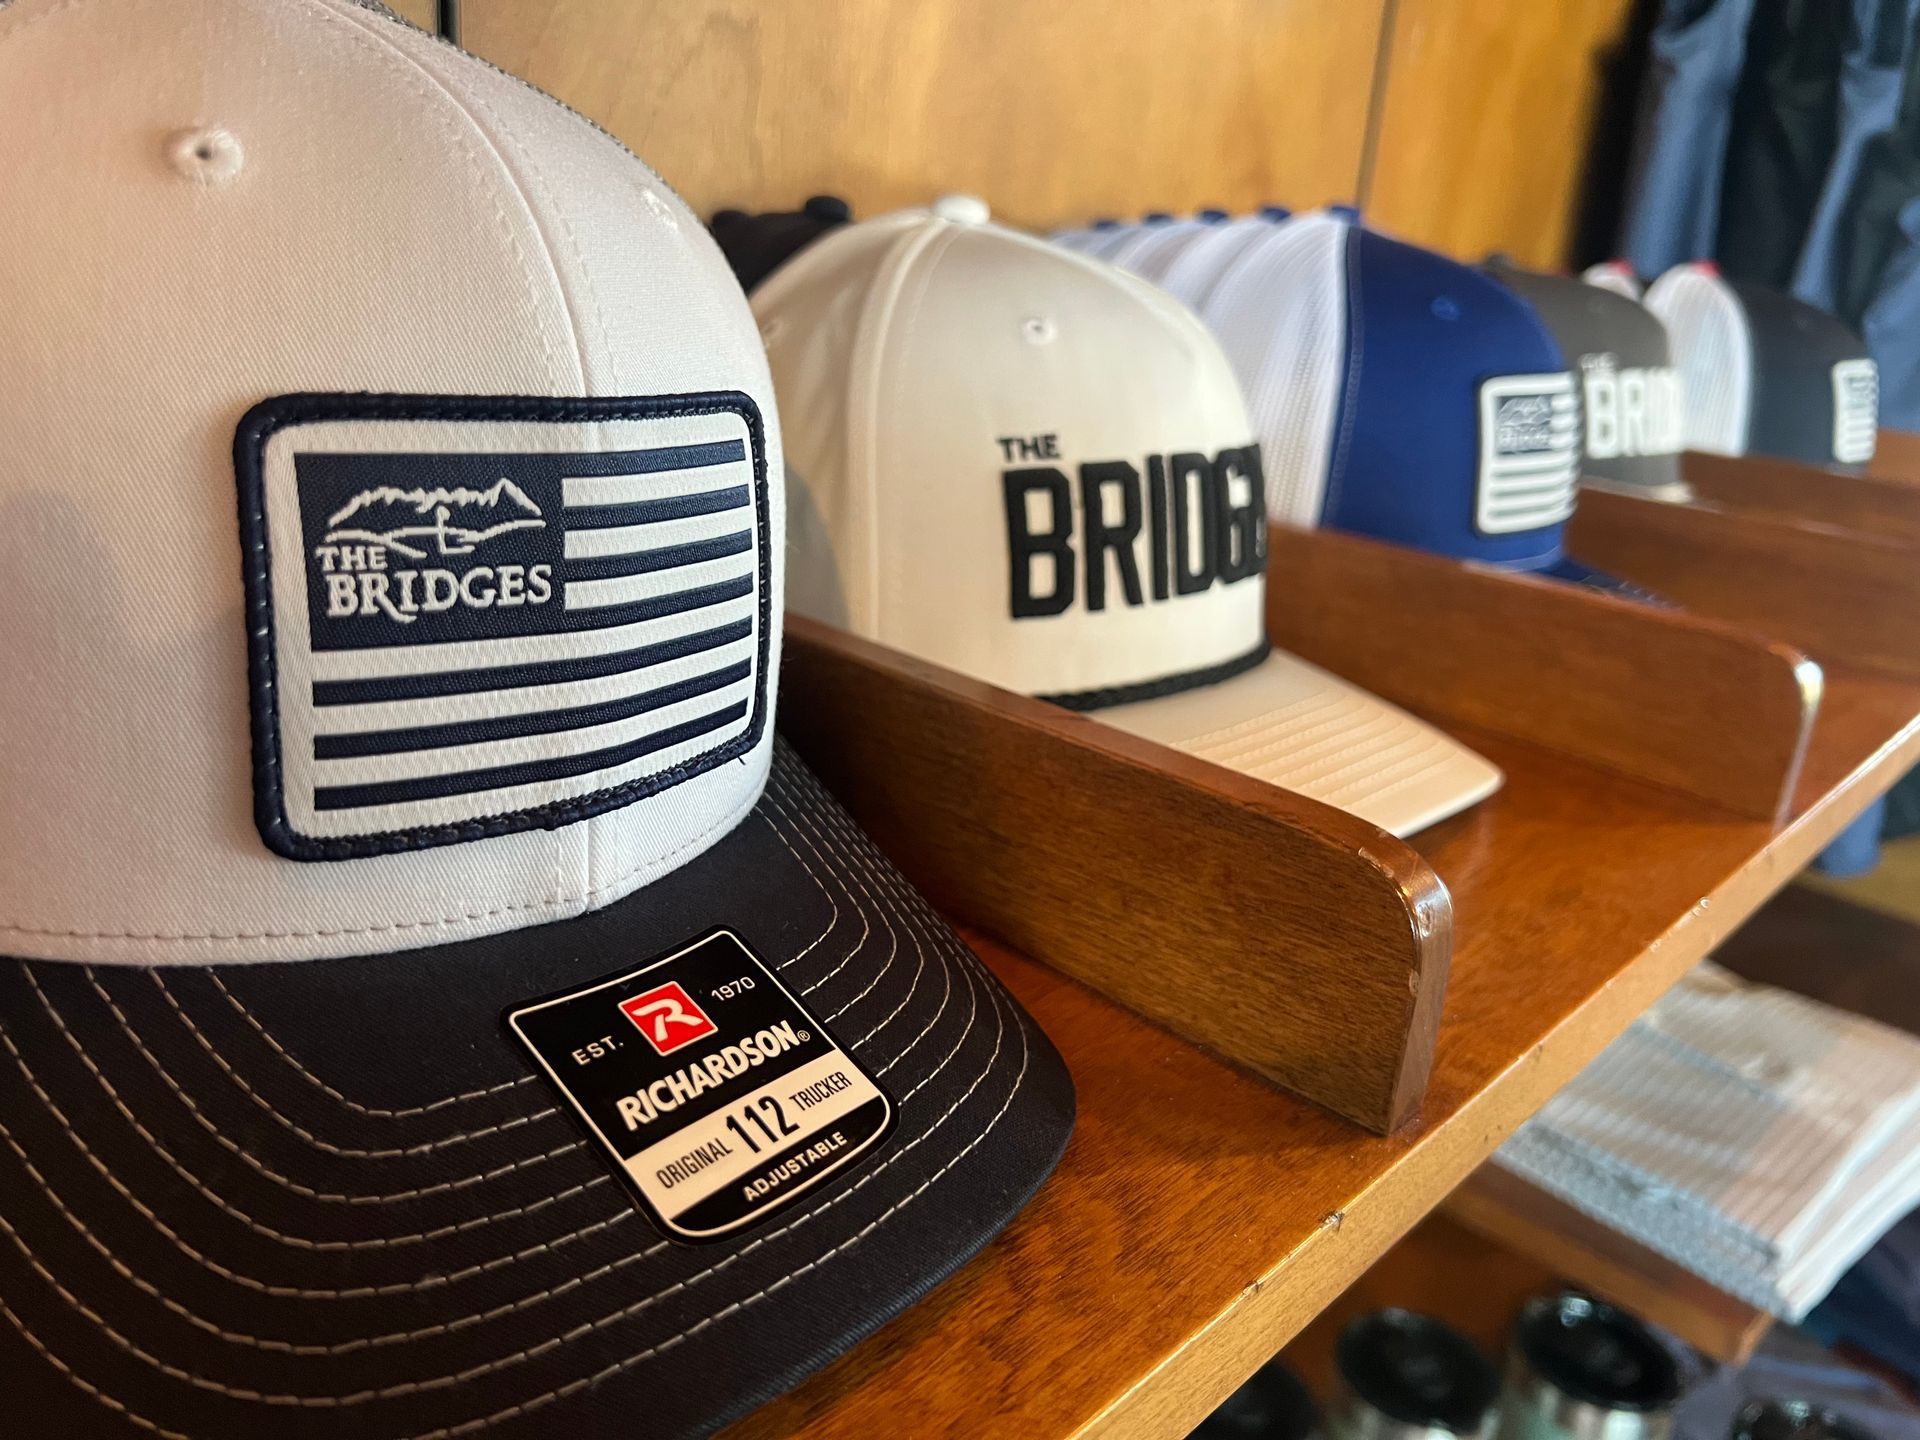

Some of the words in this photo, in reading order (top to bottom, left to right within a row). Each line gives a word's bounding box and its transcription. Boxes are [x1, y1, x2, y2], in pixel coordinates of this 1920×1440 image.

[996, 434, 1061, 462] THE
[315, 545, 388, 571] THE
[325, 564, 552, 624] BRIDGES
[571, 1035, 624, 1066] EST.
[710, 975, 756, 1002] 1970
[655, 1136, 733, 1189] ORIGINAL
[725, 1095, 800, 1154] 112
[788, 1070, 853, 1112] TRUCKER
[741, 1131, 848, 1203] ADJUSTABLE
